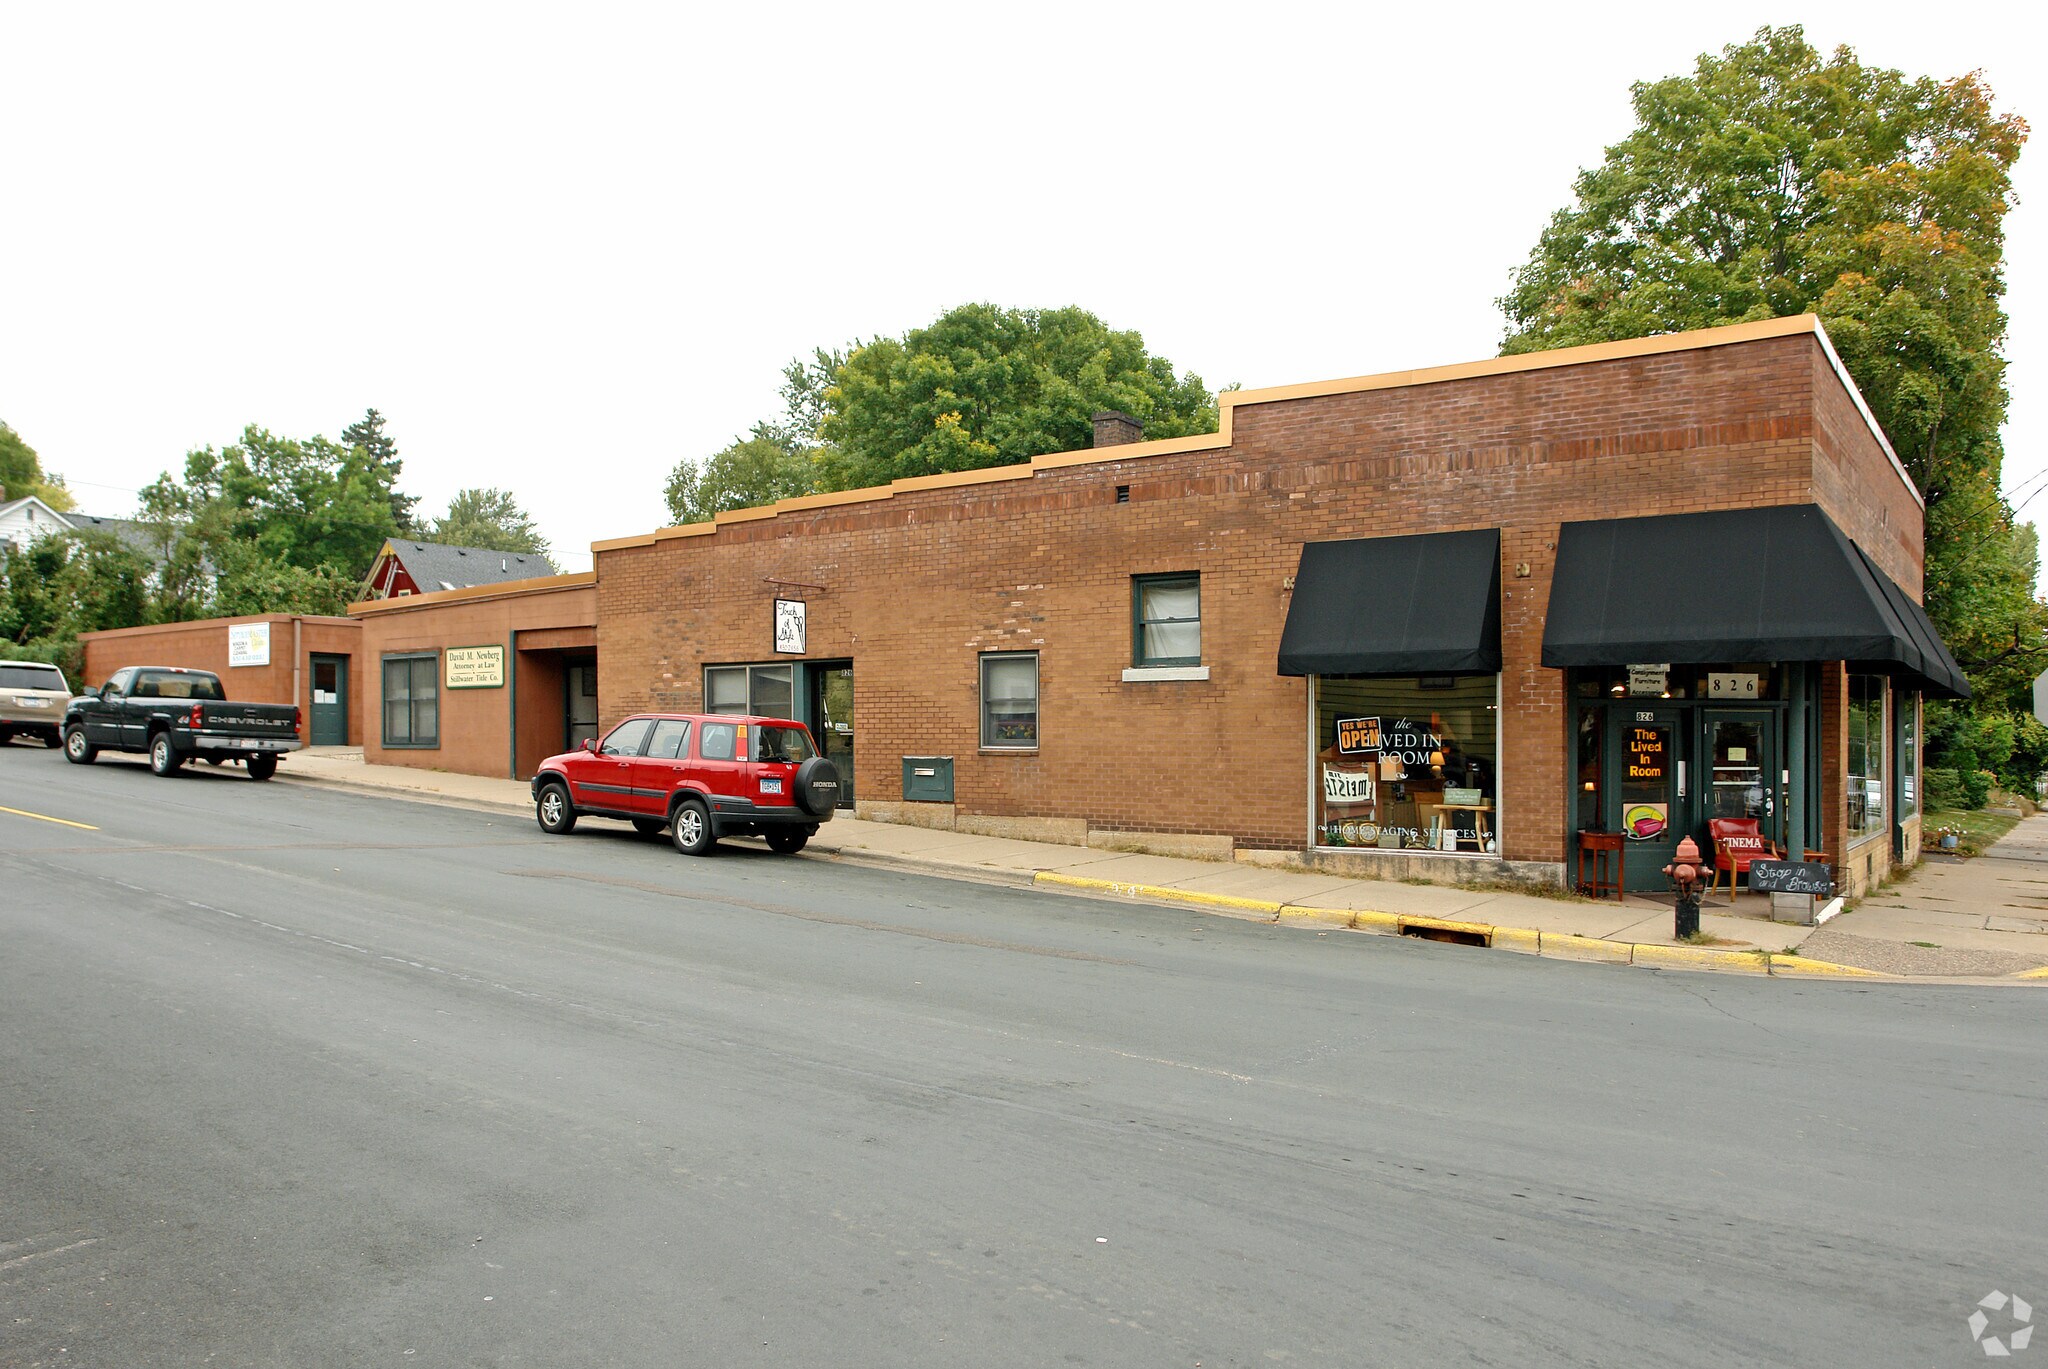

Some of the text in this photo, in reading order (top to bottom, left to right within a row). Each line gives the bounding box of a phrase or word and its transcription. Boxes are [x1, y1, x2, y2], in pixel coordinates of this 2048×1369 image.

[449, 652, 465, 661] David
[476, 650, 500, 662] Newberg
[476, 674, 488, 682] Title
[489, 673, 499, 681] Co.
[1631, 669, 1665, 677] Consignment
[208, 716, 290, 726] CHEVROLET
[1637, 712, 1653, 721] 826
[1341, 720, 1377, 731] YES WE'RE
[1394, 717, 1413, 730] the
[1341, 729, 1379, 749] OPEN
[1635, 729, 1657, 740] The
[1422, 733, 1442, 748] IN
[1630, 741, 1662, 752] Lived
[1377, 750, 1431, 765] ROOM
[1640, 754, 1650, 764] In
[1629, 765, 1661, 777] Room
[1755, 863, 1806, 880] Stop in
[1758, 876, 1828, 893] and Browse
